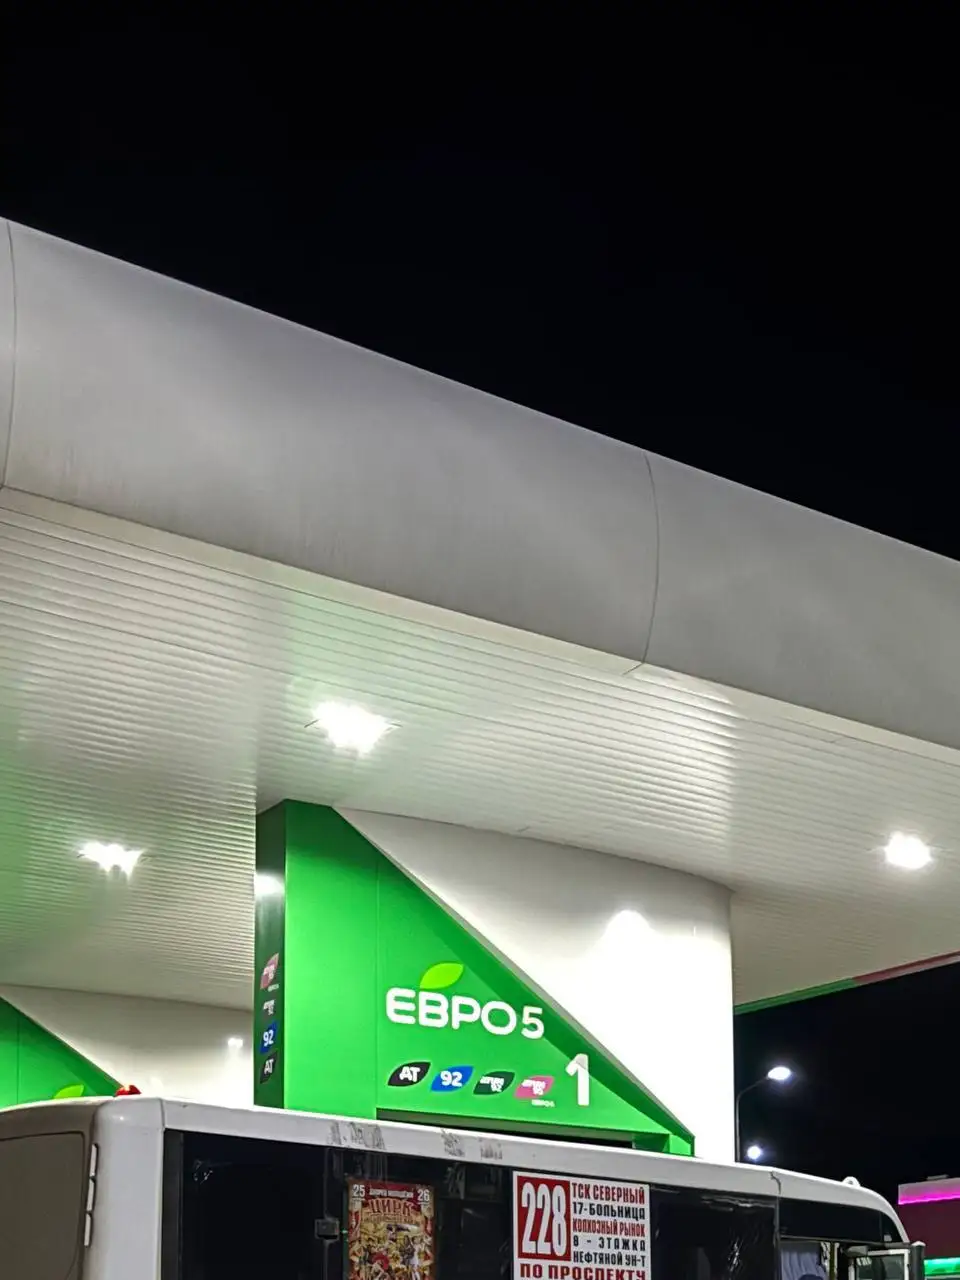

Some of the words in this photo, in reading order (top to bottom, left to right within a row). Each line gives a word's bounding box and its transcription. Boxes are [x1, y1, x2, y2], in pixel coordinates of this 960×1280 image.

[263, 1029, 274, 1047] 92
[440, 1071, 463, 1087] 92
[565, 1053, 590, 1106] 1
[352, 1184, 366, 1198] 25
[417, 1189, 430, 1202] 26
[572, 1182, 591, 1200] ТСК
[593, 1185, 645, 1204] СЕВЕРНЫЙ
[521, 1182, 567, 1257] 228
[619, 1221, 645, 1238] РЫНОК
[598, 1237, 645, 1252] ЭТАЖКА
[573, 1251, 623, 1266] НЕФТЯНОЙ
[520, 1264, 543, 1279] ПО
